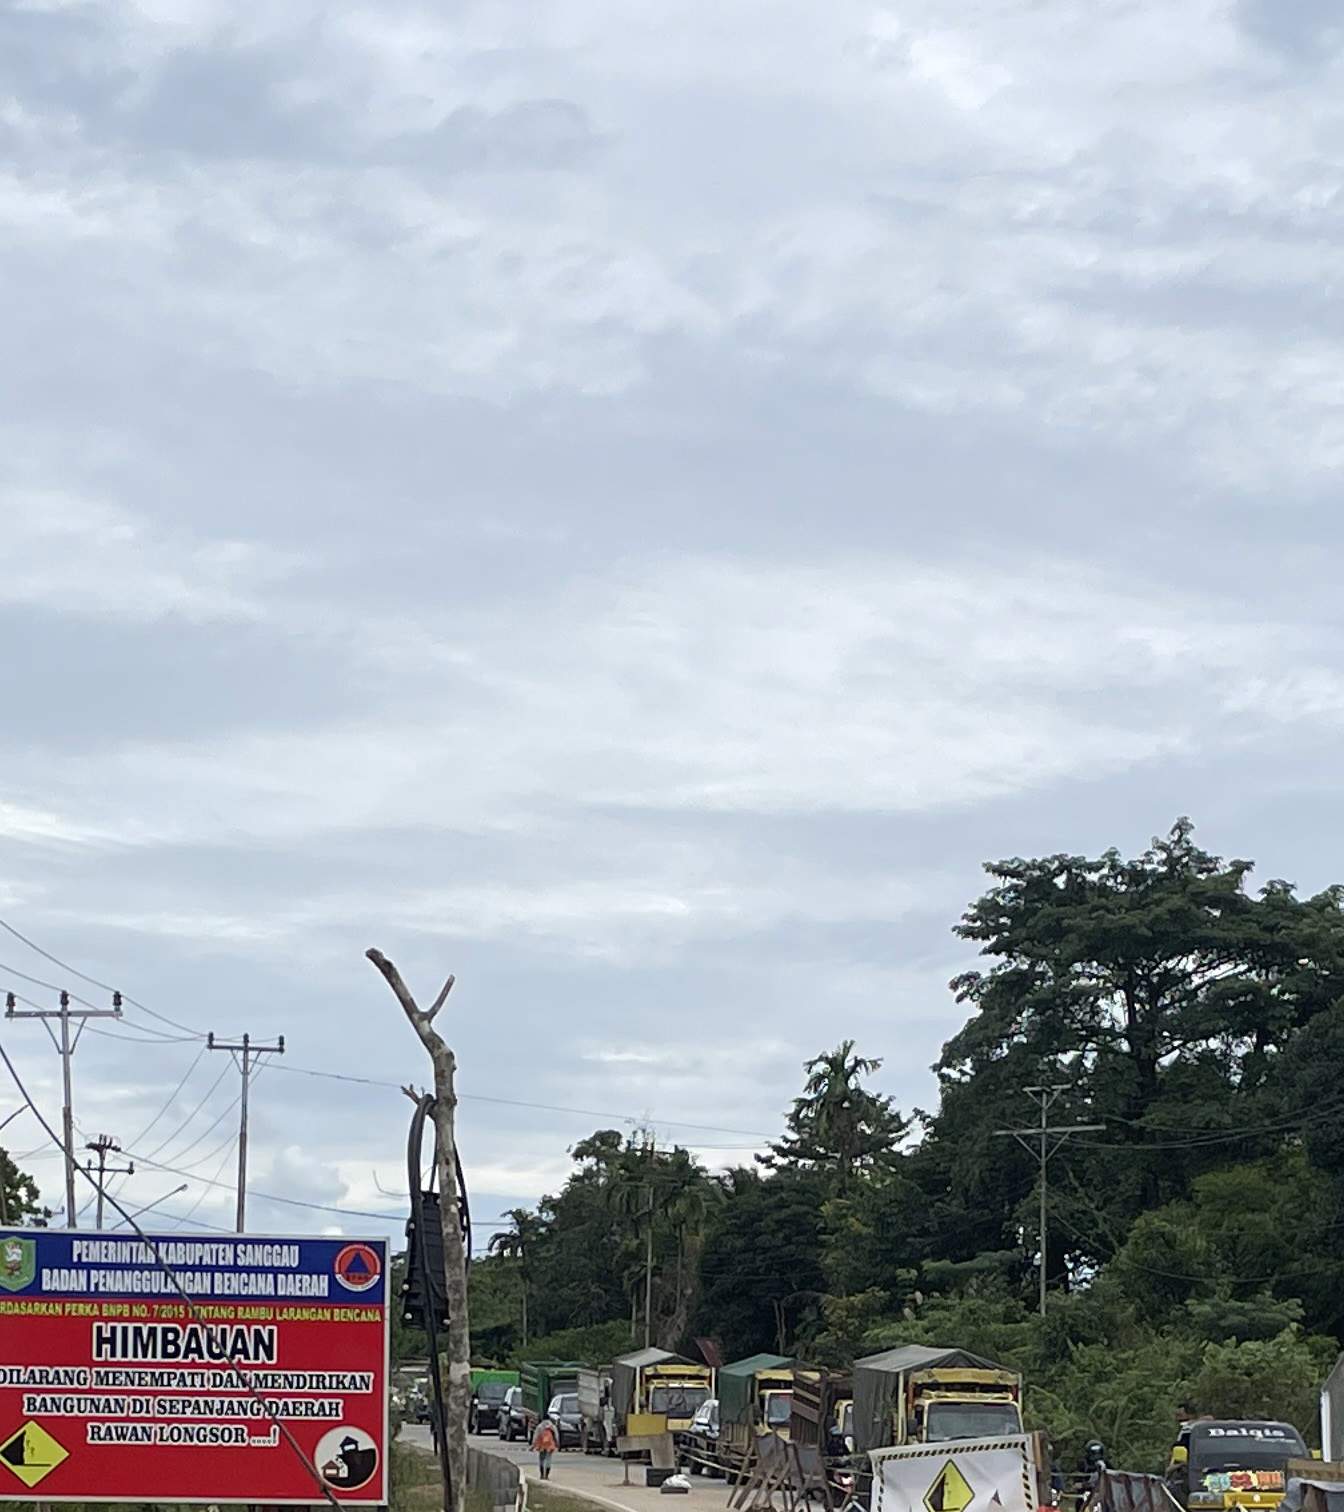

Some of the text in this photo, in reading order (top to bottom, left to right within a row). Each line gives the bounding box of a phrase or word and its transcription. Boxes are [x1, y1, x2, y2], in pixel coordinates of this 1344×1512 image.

[72, 1240, 299, 1268] PEMERINTAH KABUPATEN SANGGAU
[42, 1268, 87, 1292] BADAN
[90, 1269, 212, 1296] PENANGGULANGAN
[214, 1272, 275, 1296] BENCANA
[277, 1273, 329, 1297] DAERAH
[276, 1307, 331, 1322] LARANGAN
[333, 1308, 381, 1322] BENCANA
[96, 1325, 275, 1361] HIMBAUAN
[94, 1370, 205, 1388] MENEMPATI
[255, 1372, 371, 1390] MENDIRIKAN
[26, 1396, 341, 1417] BANGUNAN DI SEPANJANG DAERAH
[89, 1424, 153, 1442] RAWAN
[158, 1425, 246, 1444] LONGSOR
